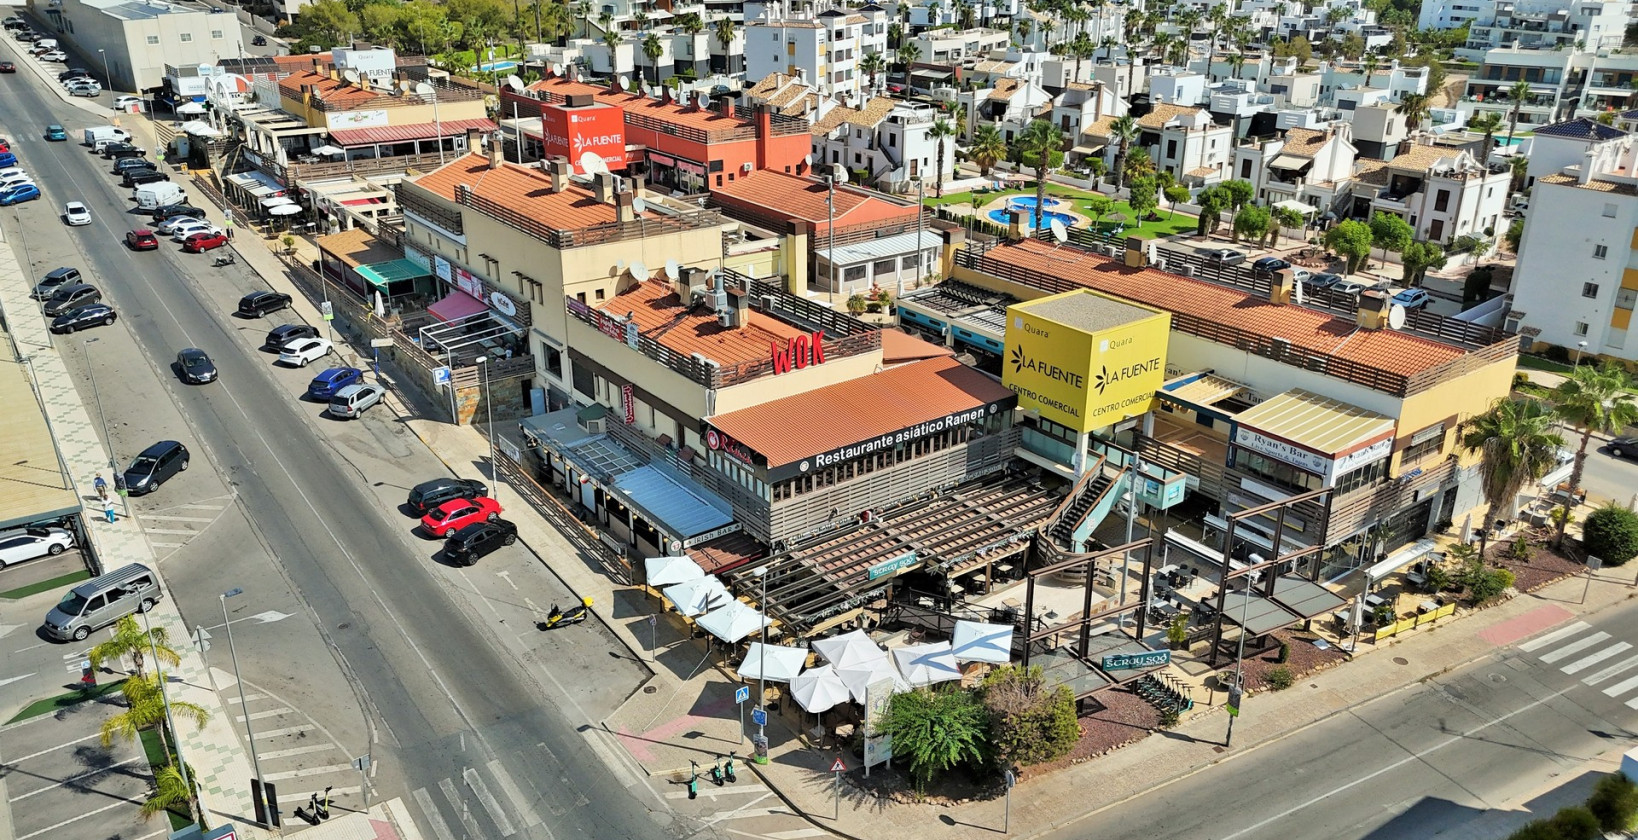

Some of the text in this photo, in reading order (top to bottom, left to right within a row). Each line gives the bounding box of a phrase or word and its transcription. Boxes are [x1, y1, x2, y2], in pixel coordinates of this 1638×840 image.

[582, 134, 621, 147] LA FUENTE
[1024, 322, 1049, 338] Quara
[771, 329, 826, 375] WOK
[1109, 337, 1133, 350] Quara
[1022, 355, 1083, 389] LA FUENTE
[1106, 357, 1160, 385] LA FUENTE
[1009, 383, 1080, 418] CENTRO COMERCIAL
[1092, 402, 1120, 417] CENTRO
[815, 408, 984, 468] Restaurante asiático Ramen
[1254, 434, 1308, 459] Ryan's Bar
[717, 526, 733, 537] BAR
